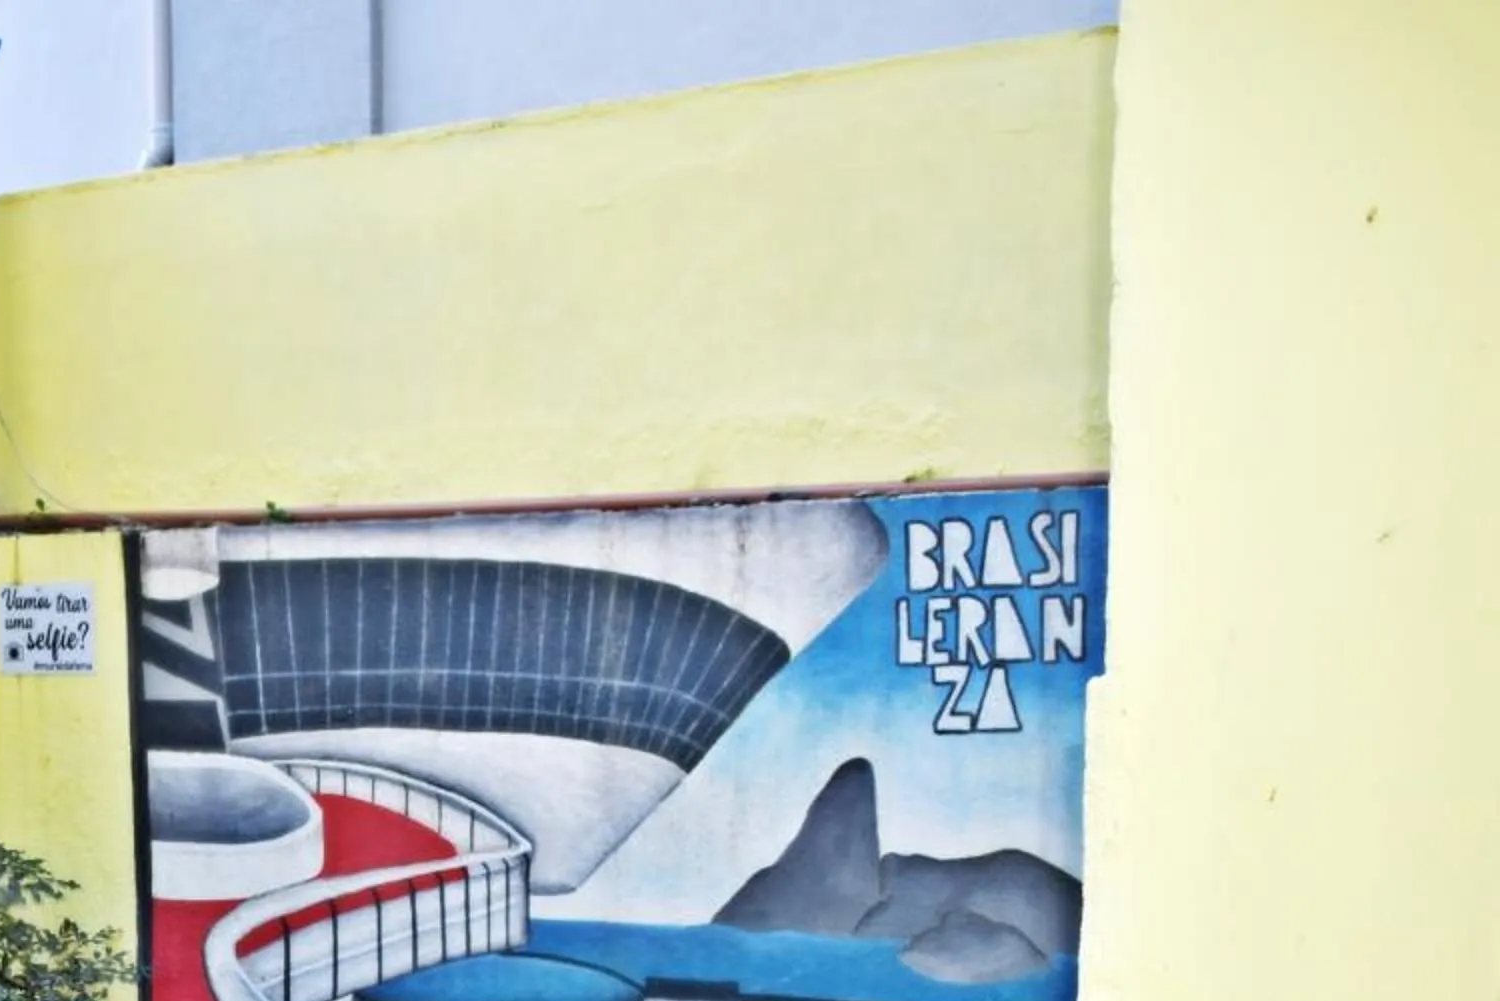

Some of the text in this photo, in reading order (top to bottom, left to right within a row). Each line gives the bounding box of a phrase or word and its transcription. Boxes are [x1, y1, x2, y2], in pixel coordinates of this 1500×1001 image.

[906, 510, 1080, 592] BRASI
[26, 621, 90, 662] selfie?
[896, 594, 1087, 668] LERAN
[932, 664, 1023, 734] ZA
